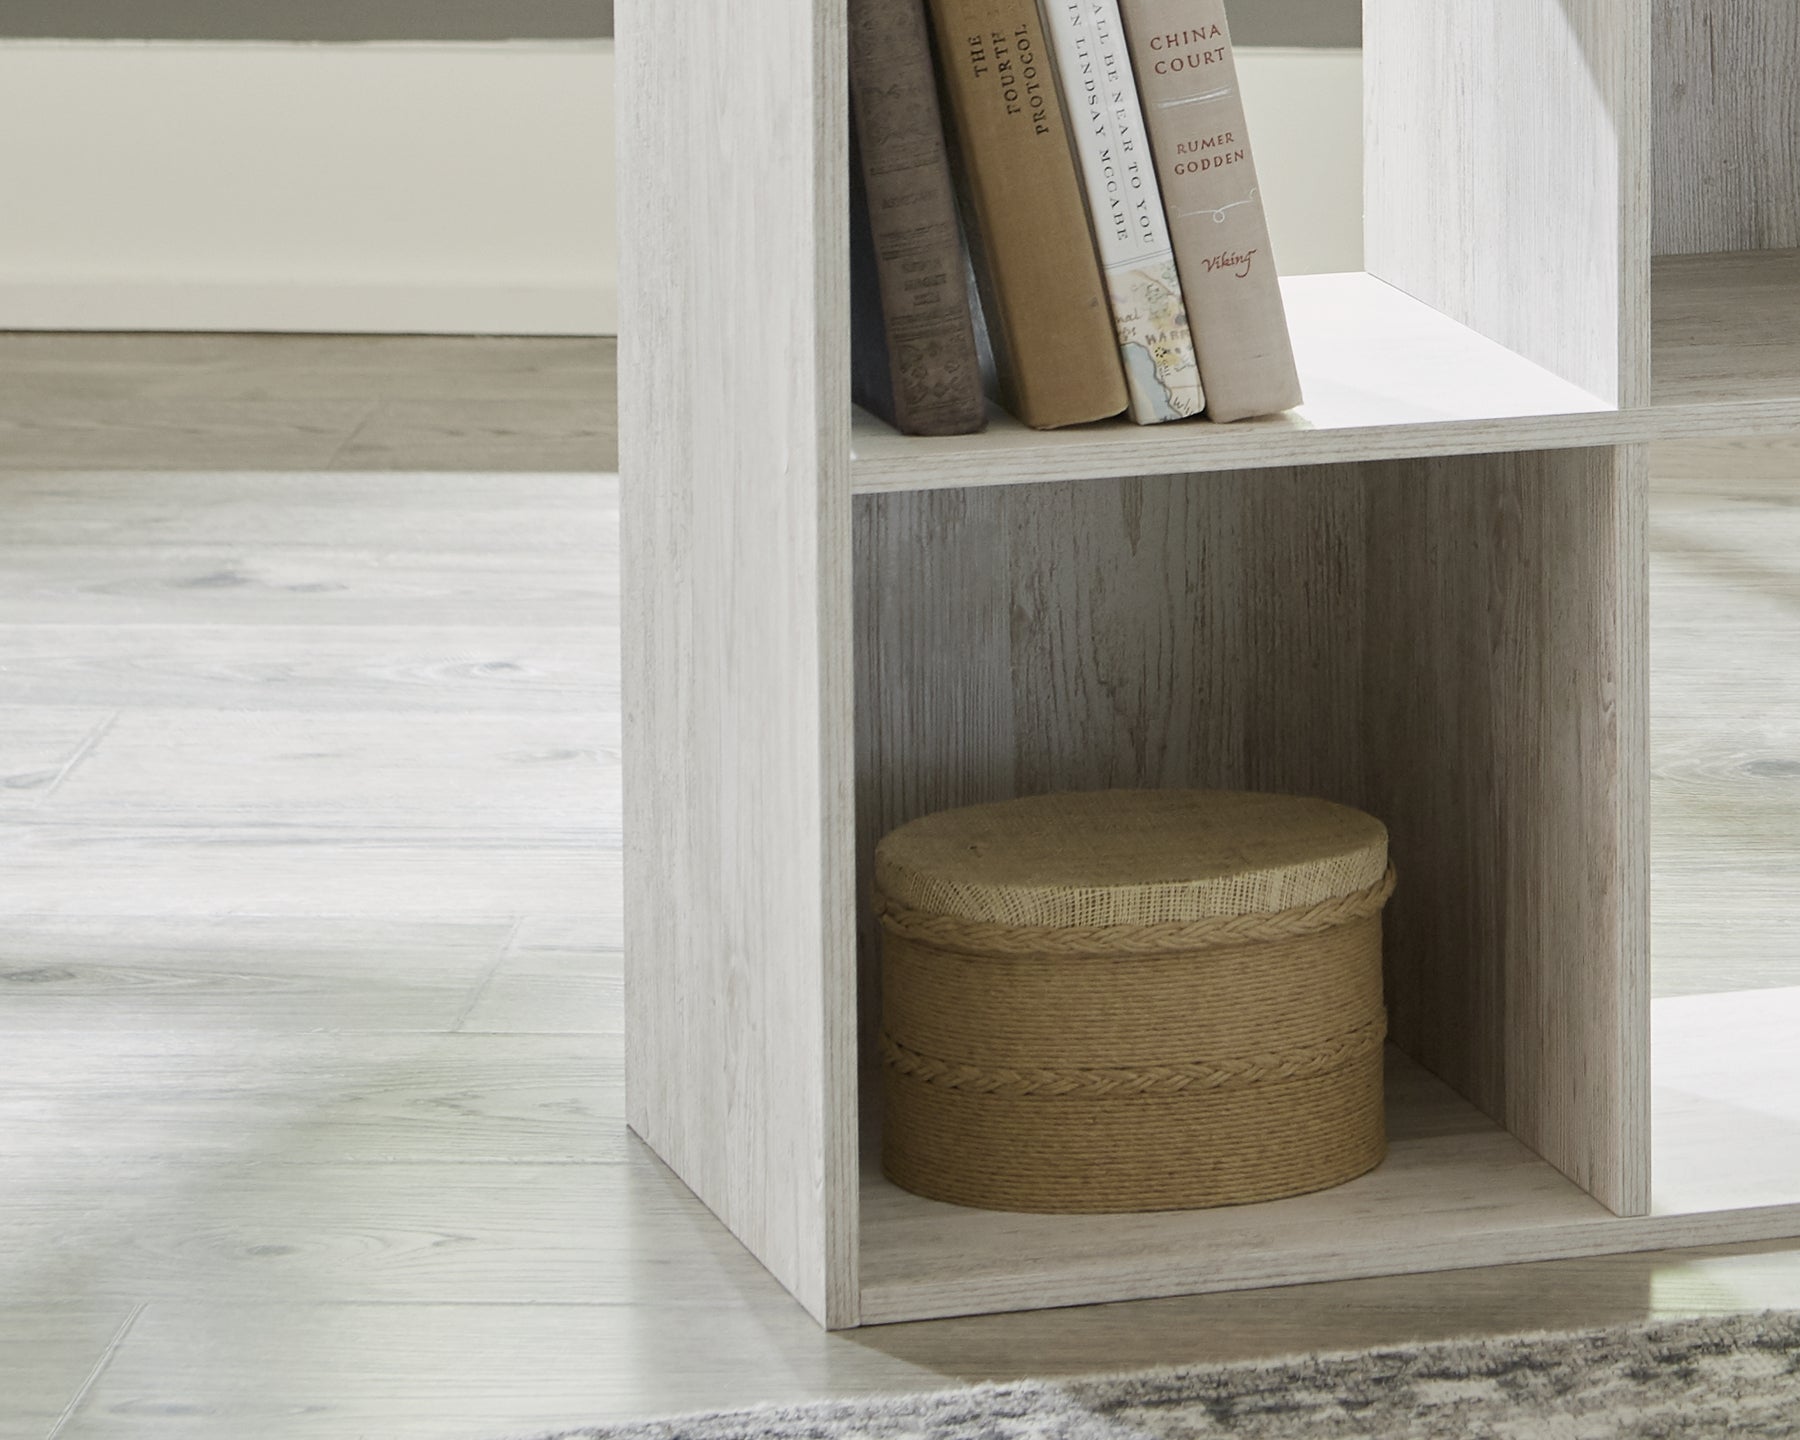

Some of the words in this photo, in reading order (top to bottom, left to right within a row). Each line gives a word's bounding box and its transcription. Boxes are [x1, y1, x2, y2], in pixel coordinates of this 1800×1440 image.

[1149, 24, 1222, 51] CHINA
[967, 33, 988, 78] THE
[1154, 47, 1226, 75] COURT
[1014, 23, 1049, 136] PROTOCOL
[1076, 38, 1106, 137] LINDSAY
[1103, 54, 1118, 82] BE
[1112, 91, 1134, 153] NEAR
[1128, 161, 1142, 189] TO
[1136, 199, 1154, 244] YOU
[1177, 131, 1235, 155] RUMER
[1174, 149, 1245, 176] GODDEN
[1201, 249, 1257, 279] Viking
